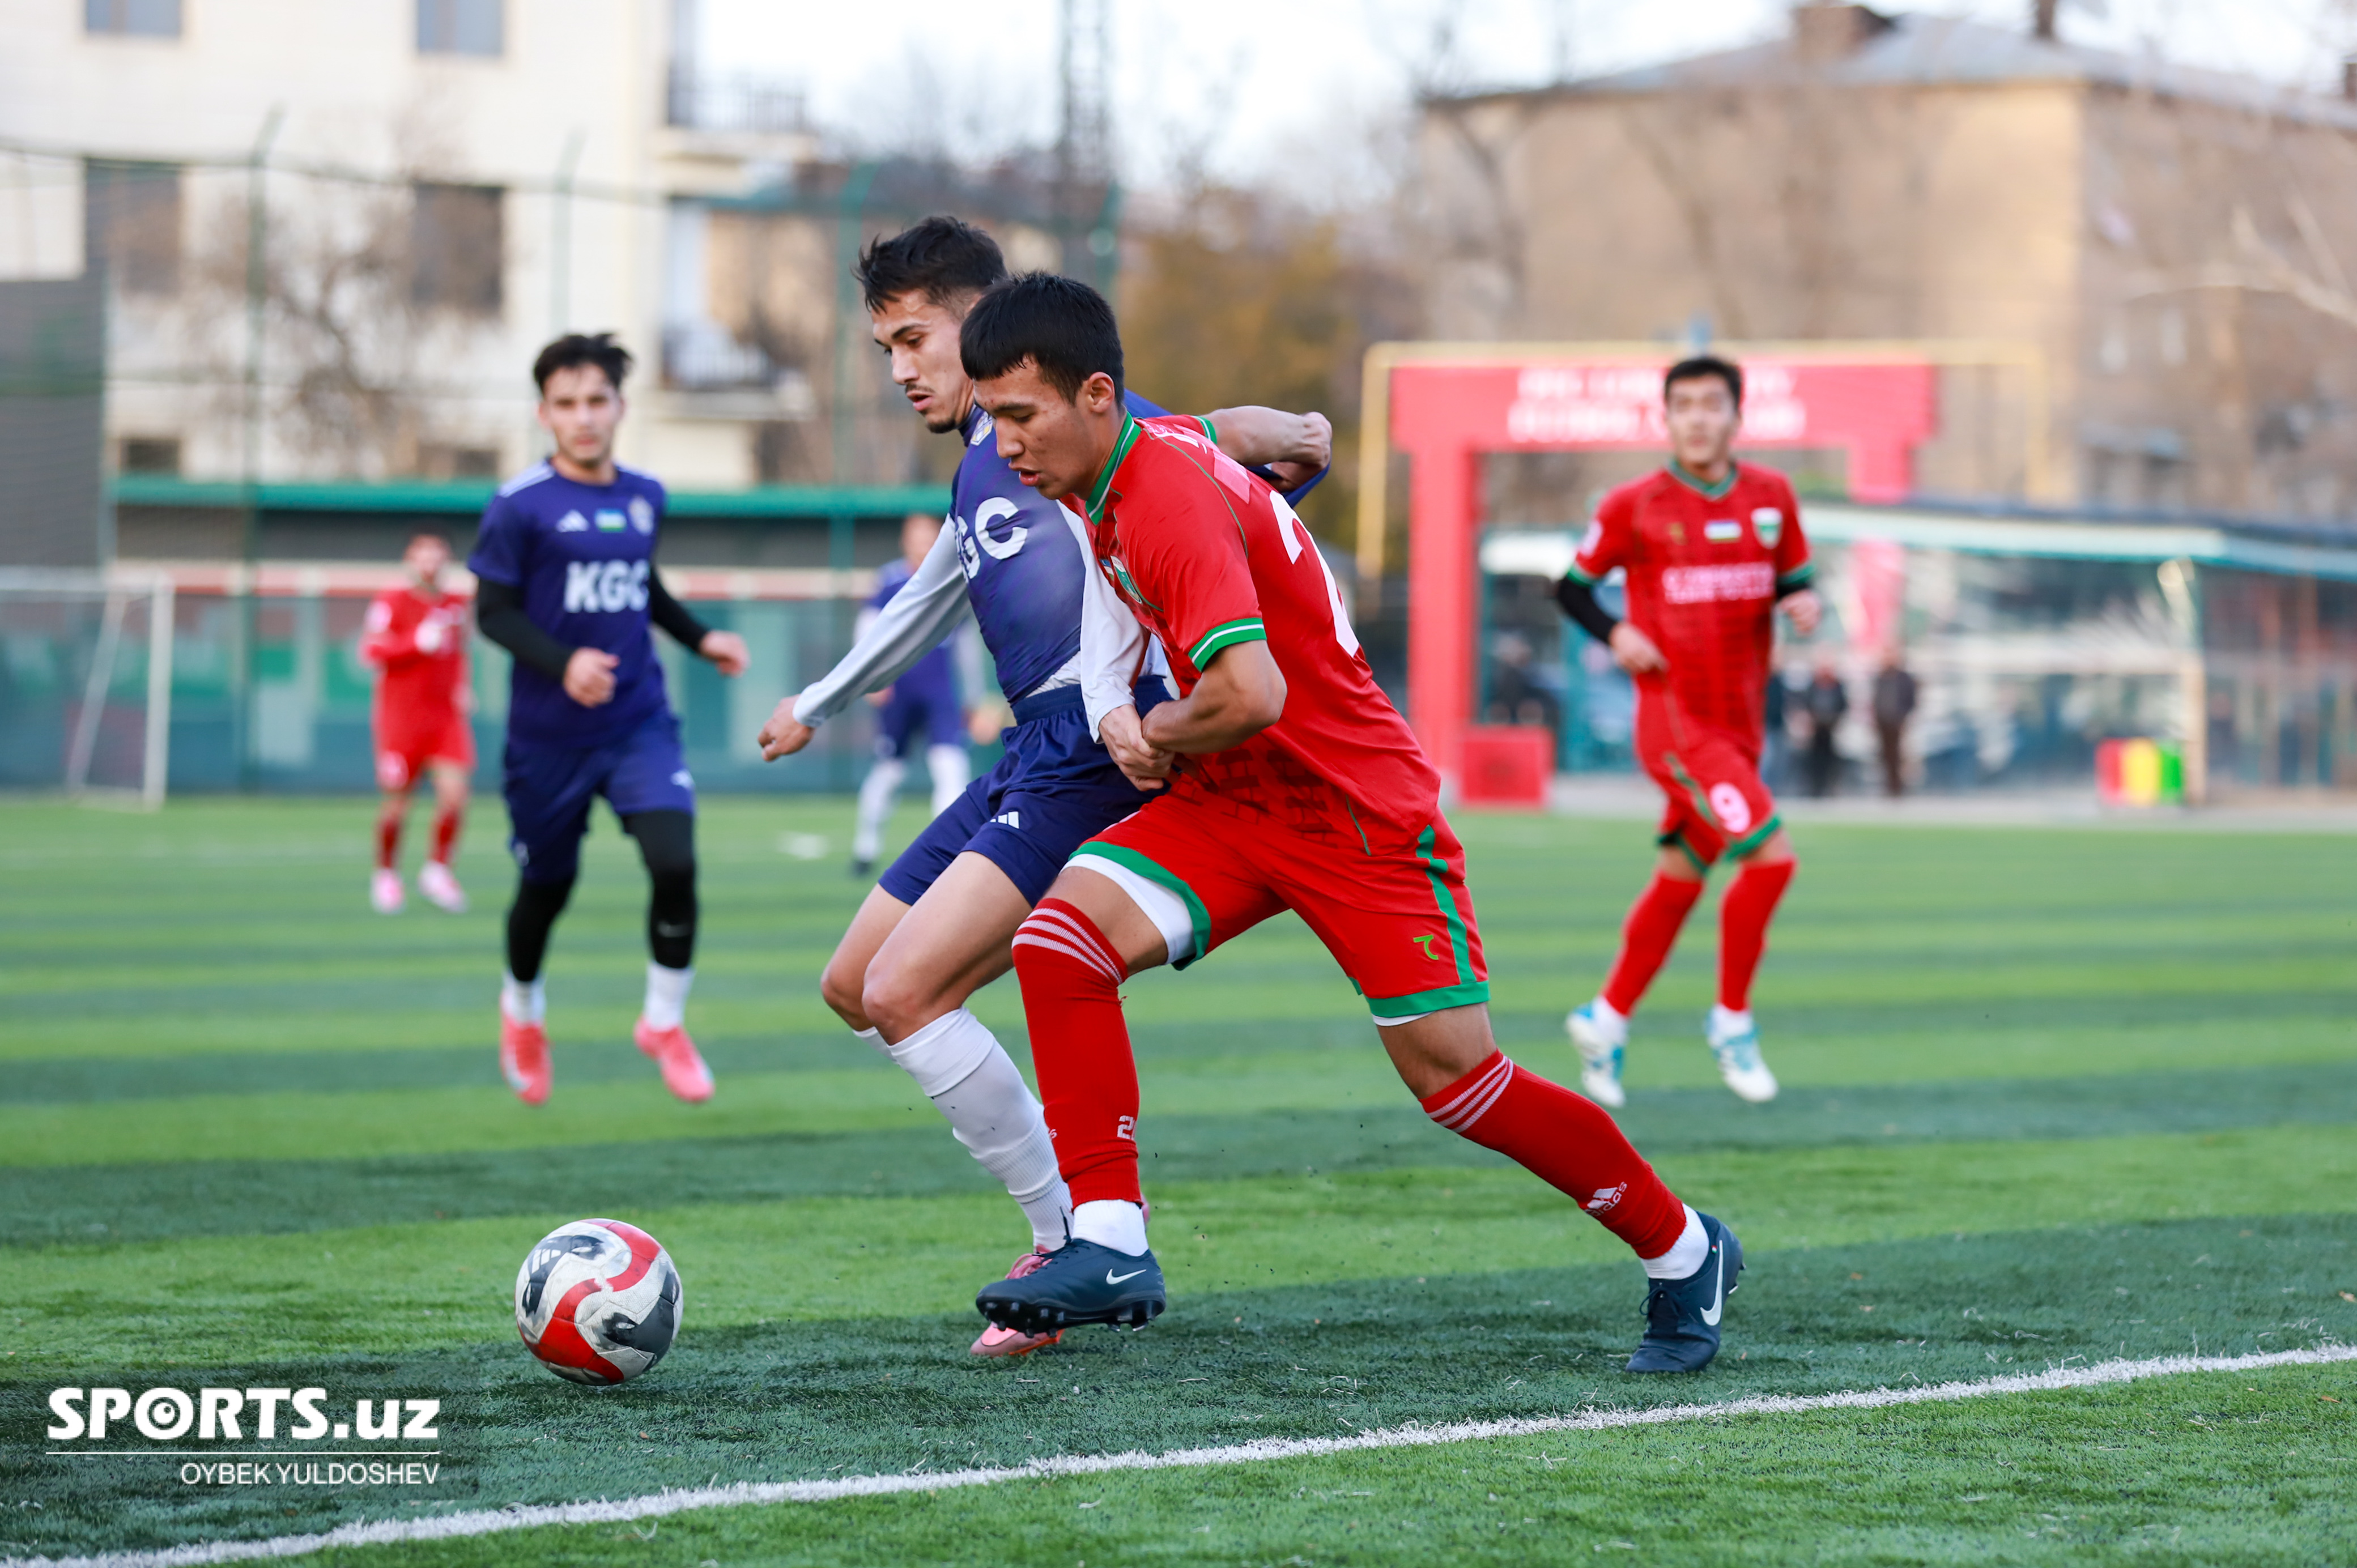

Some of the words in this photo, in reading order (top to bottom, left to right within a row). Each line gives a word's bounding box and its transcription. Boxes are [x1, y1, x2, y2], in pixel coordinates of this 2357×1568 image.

[955, 496, 1028, 583] GC
[564, 559, 650, 613] KGC
[1117, 1115, 1135, 1140] 2
